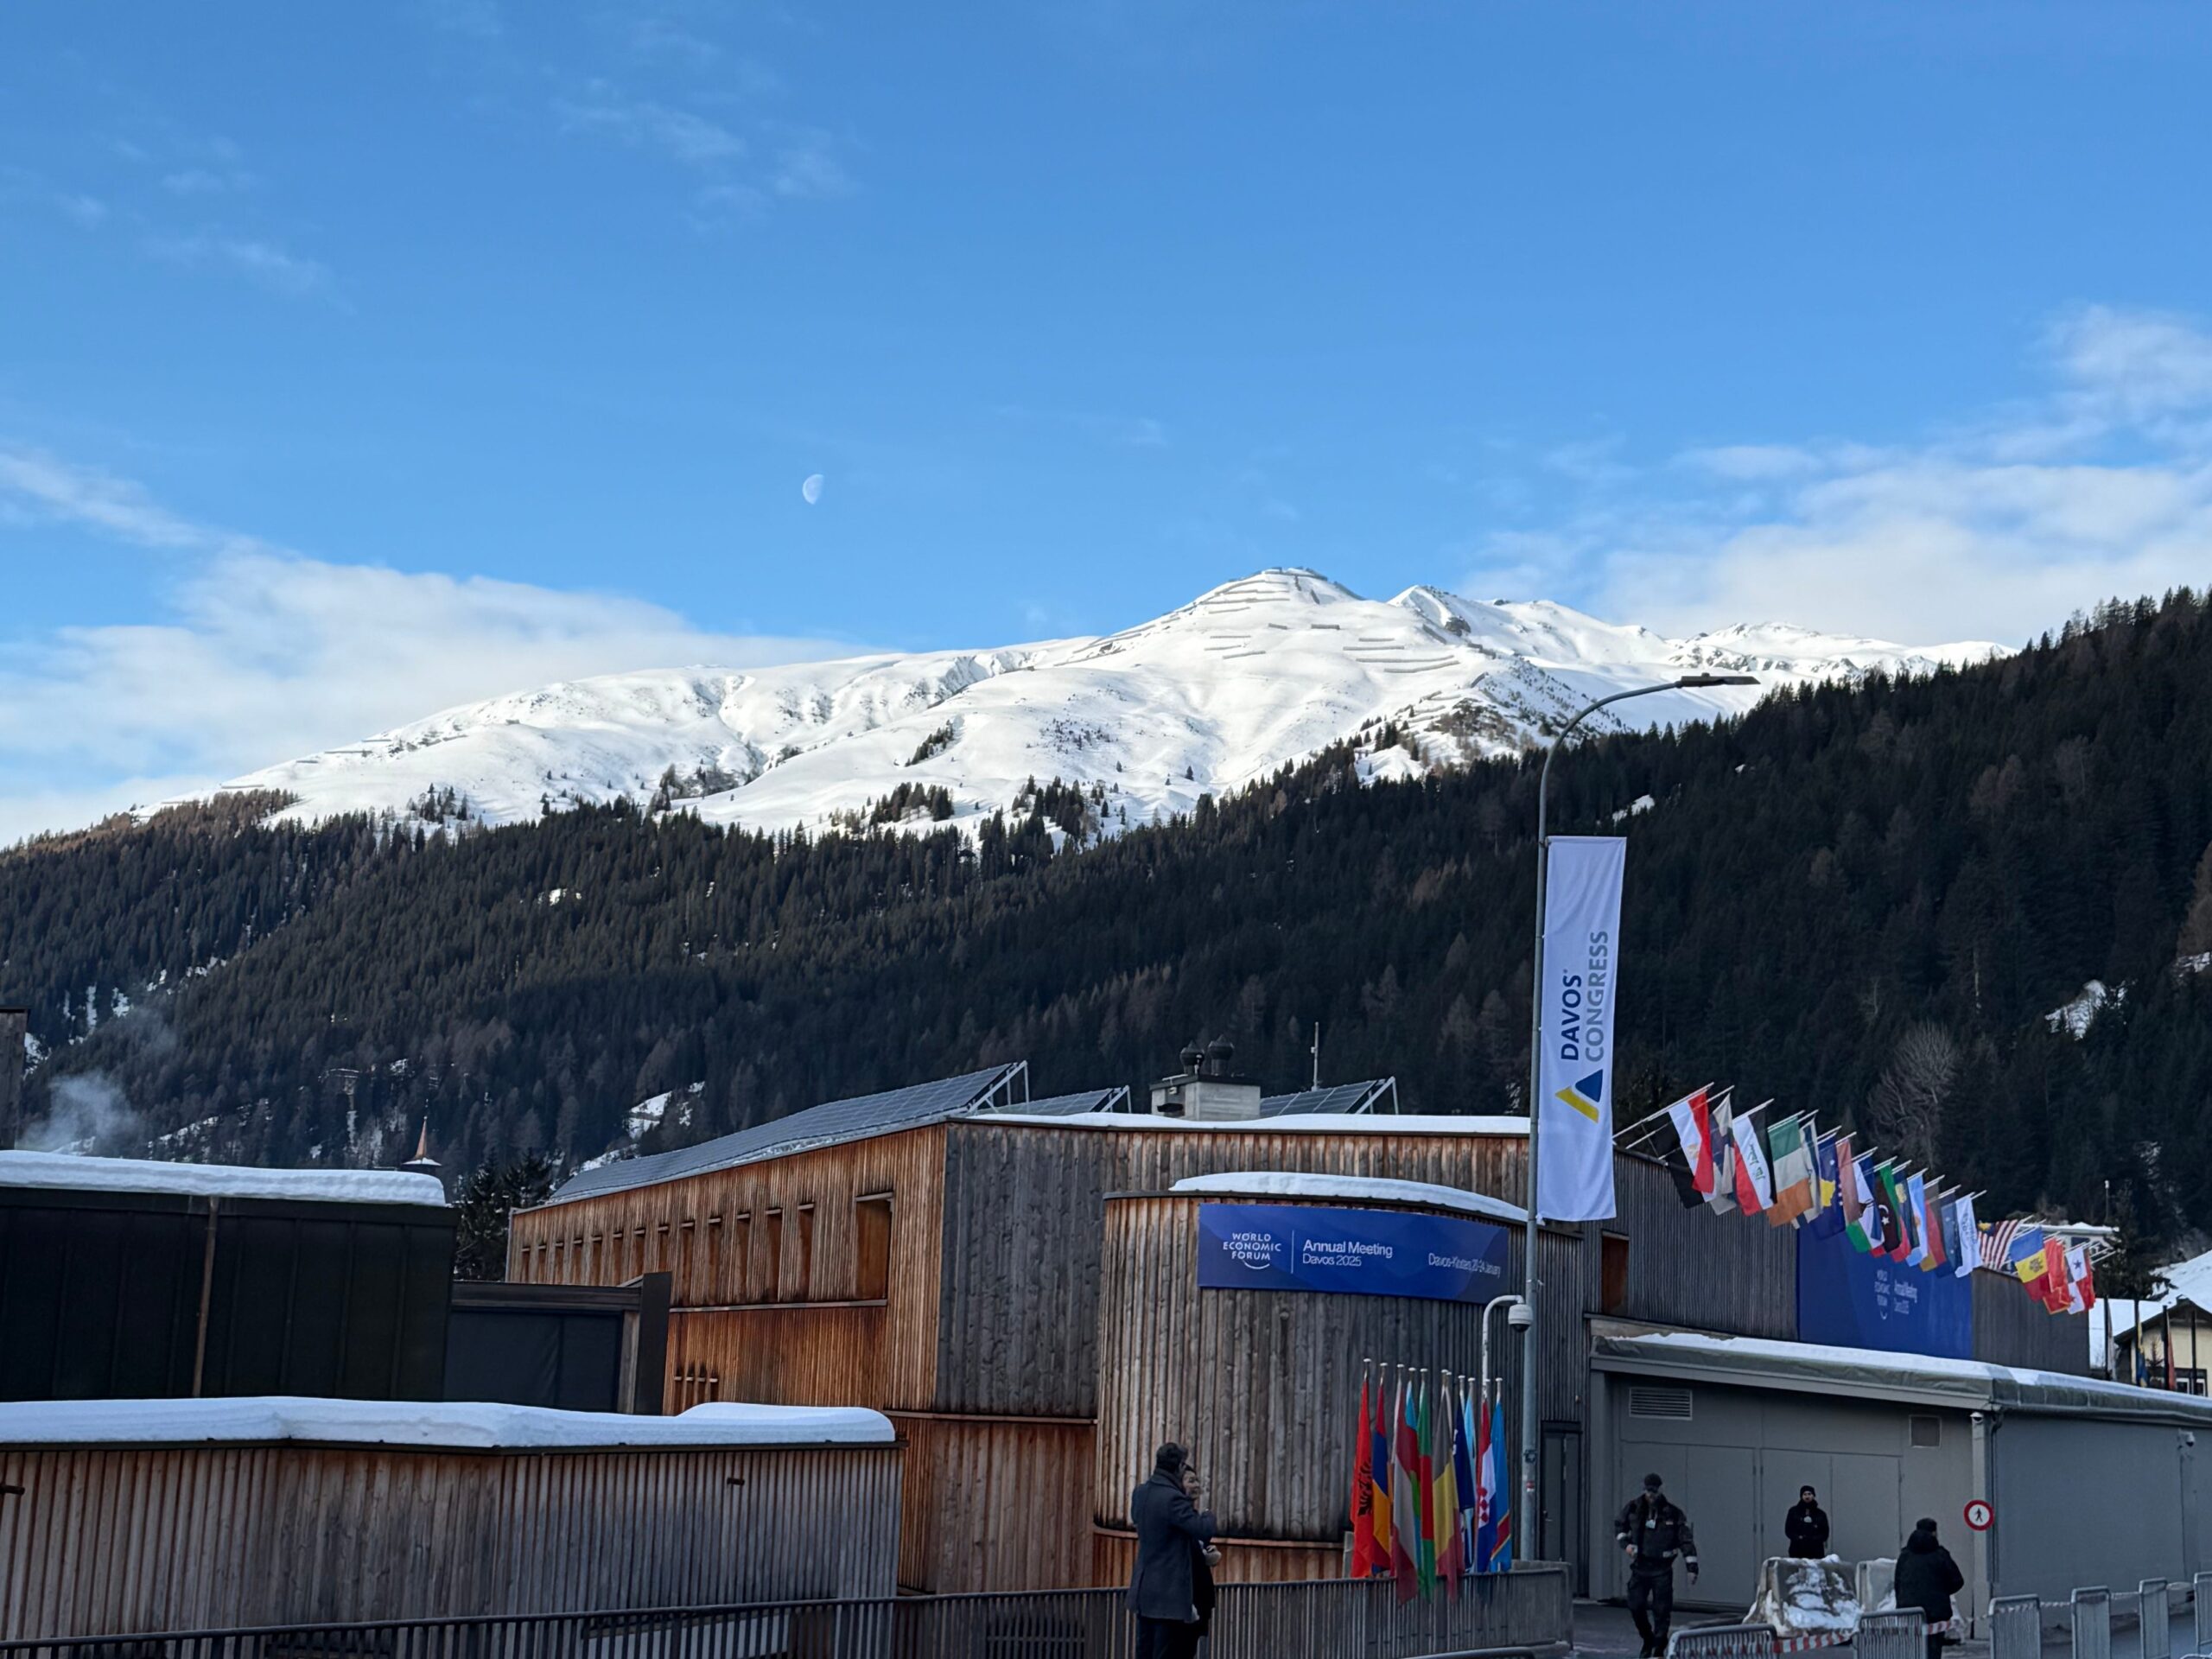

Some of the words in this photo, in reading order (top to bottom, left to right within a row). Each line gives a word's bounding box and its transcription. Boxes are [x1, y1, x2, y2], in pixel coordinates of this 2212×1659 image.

[1585, 931, 1609, 1062] CONGRESS
[1560, 975, 1582, 1061] DAVOS
[1231, 1232, 1272, 1242] WORLD
[1223, 1242, 1282, 1252] ECONOMIC
[1302, 1238, 1347, 1253] Annual
[1348, 1241, 1394, 1259] Meeting
[1231, 1250, 1271, 1261] FORUM
[1302, 1253, 1335, 1265] Davos
[1336, 1255, 1363, 1267] 2025
